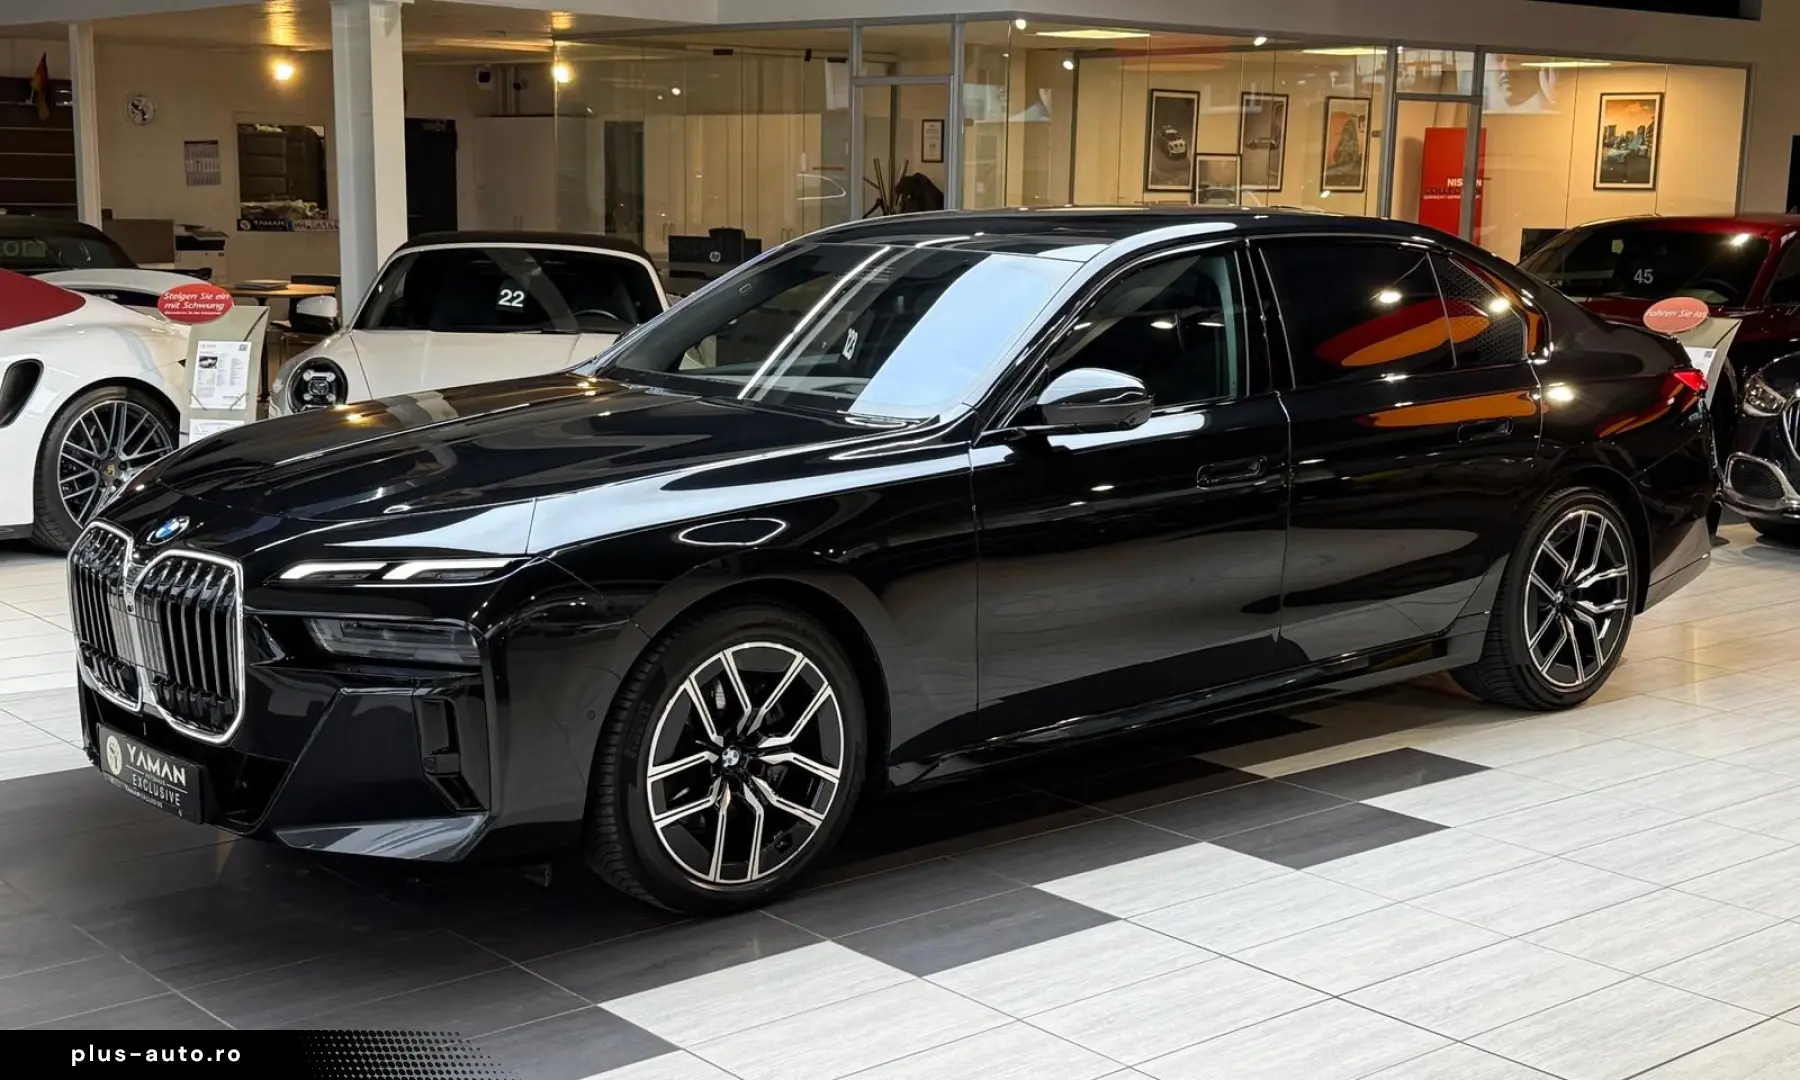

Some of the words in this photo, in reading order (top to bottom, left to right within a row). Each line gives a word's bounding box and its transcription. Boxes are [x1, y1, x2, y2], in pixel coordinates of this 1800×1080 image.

[1447, 178, 1482, 187] NISN
[1634, 269, 1654, 284] 45
[200, 291, 214, 300] Sie
[215, 292, 230, 300] ein
[498, 289, 525, 307] 22
[182, 301, 225, 310] Schwung
[126, 743, 187, 787] YAMAN
[132, 774, 181, 807] EXCLUSIVE
